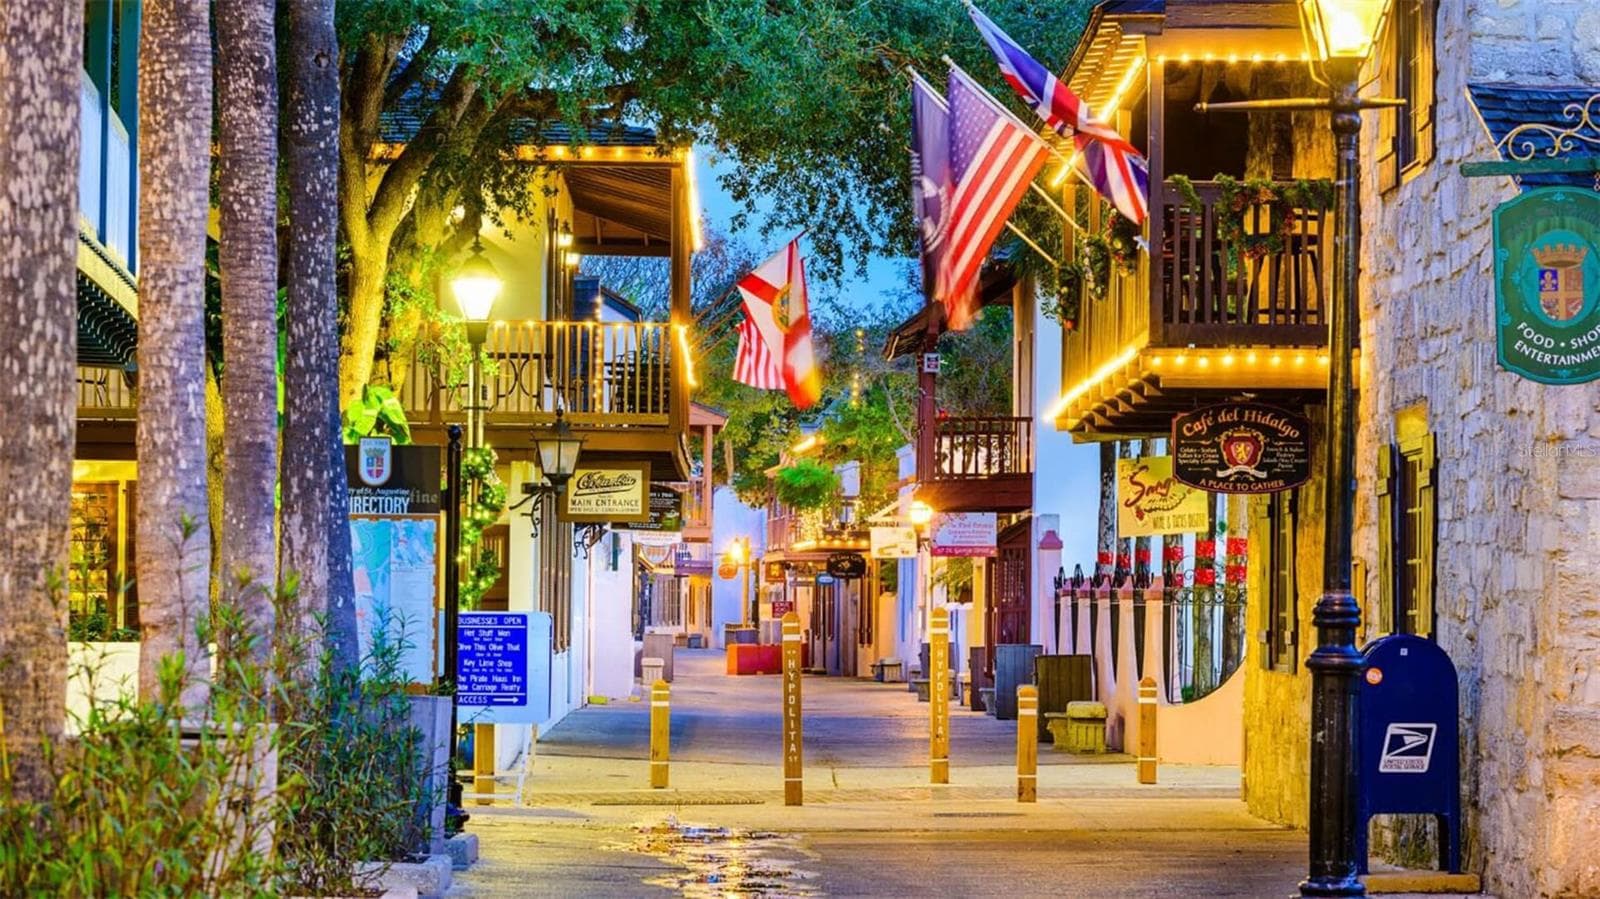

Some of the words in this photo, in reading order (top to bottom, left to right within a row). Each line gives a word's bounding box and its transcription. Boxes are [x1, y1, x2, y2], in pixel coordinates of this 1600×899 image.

[1516, 321, 1555, 349] FOOD
[1514, 340, 1600, 366] ENTERTAINME
[1182, 410, 1214, 437] Café
[1217, 408, 1239, 423] del
[1244, 409, 1300, 438] Hidalgo
[1199, 478, 1207, 486] A
[1207, 480, 1233, 491] PLACE
[1236, 482, 1249, 491] TO
[1250, 480, 1286, 491] GATHER
[349, 496, 410, 514] IRECTORY
[596, 499, 639, 507] ENTRANCE
[458, 616, 498, 625] BUSINESSES
[504, 616, 522, 625] OPEN
[478, 629, 494, 637] Stuff
[474, 642, 487, 651] This
[488, 643, 504, 651] Olive
[506, 643, 520, 652] That
[463, 659, 475, 668] Key
[478, 659, 494, 667] Lime
[497, 660, 513, 668] Shop
[470, 675, 488, 683] Pirate
[471, 683, 498, 693] Carriage
[500, 684, 521, 692] Realty
[936, 651, 944, 735] HYPOLITA
[458, 696, 488, 704] ACCESS
[787, 658, 798, 753] HYPOLITA
